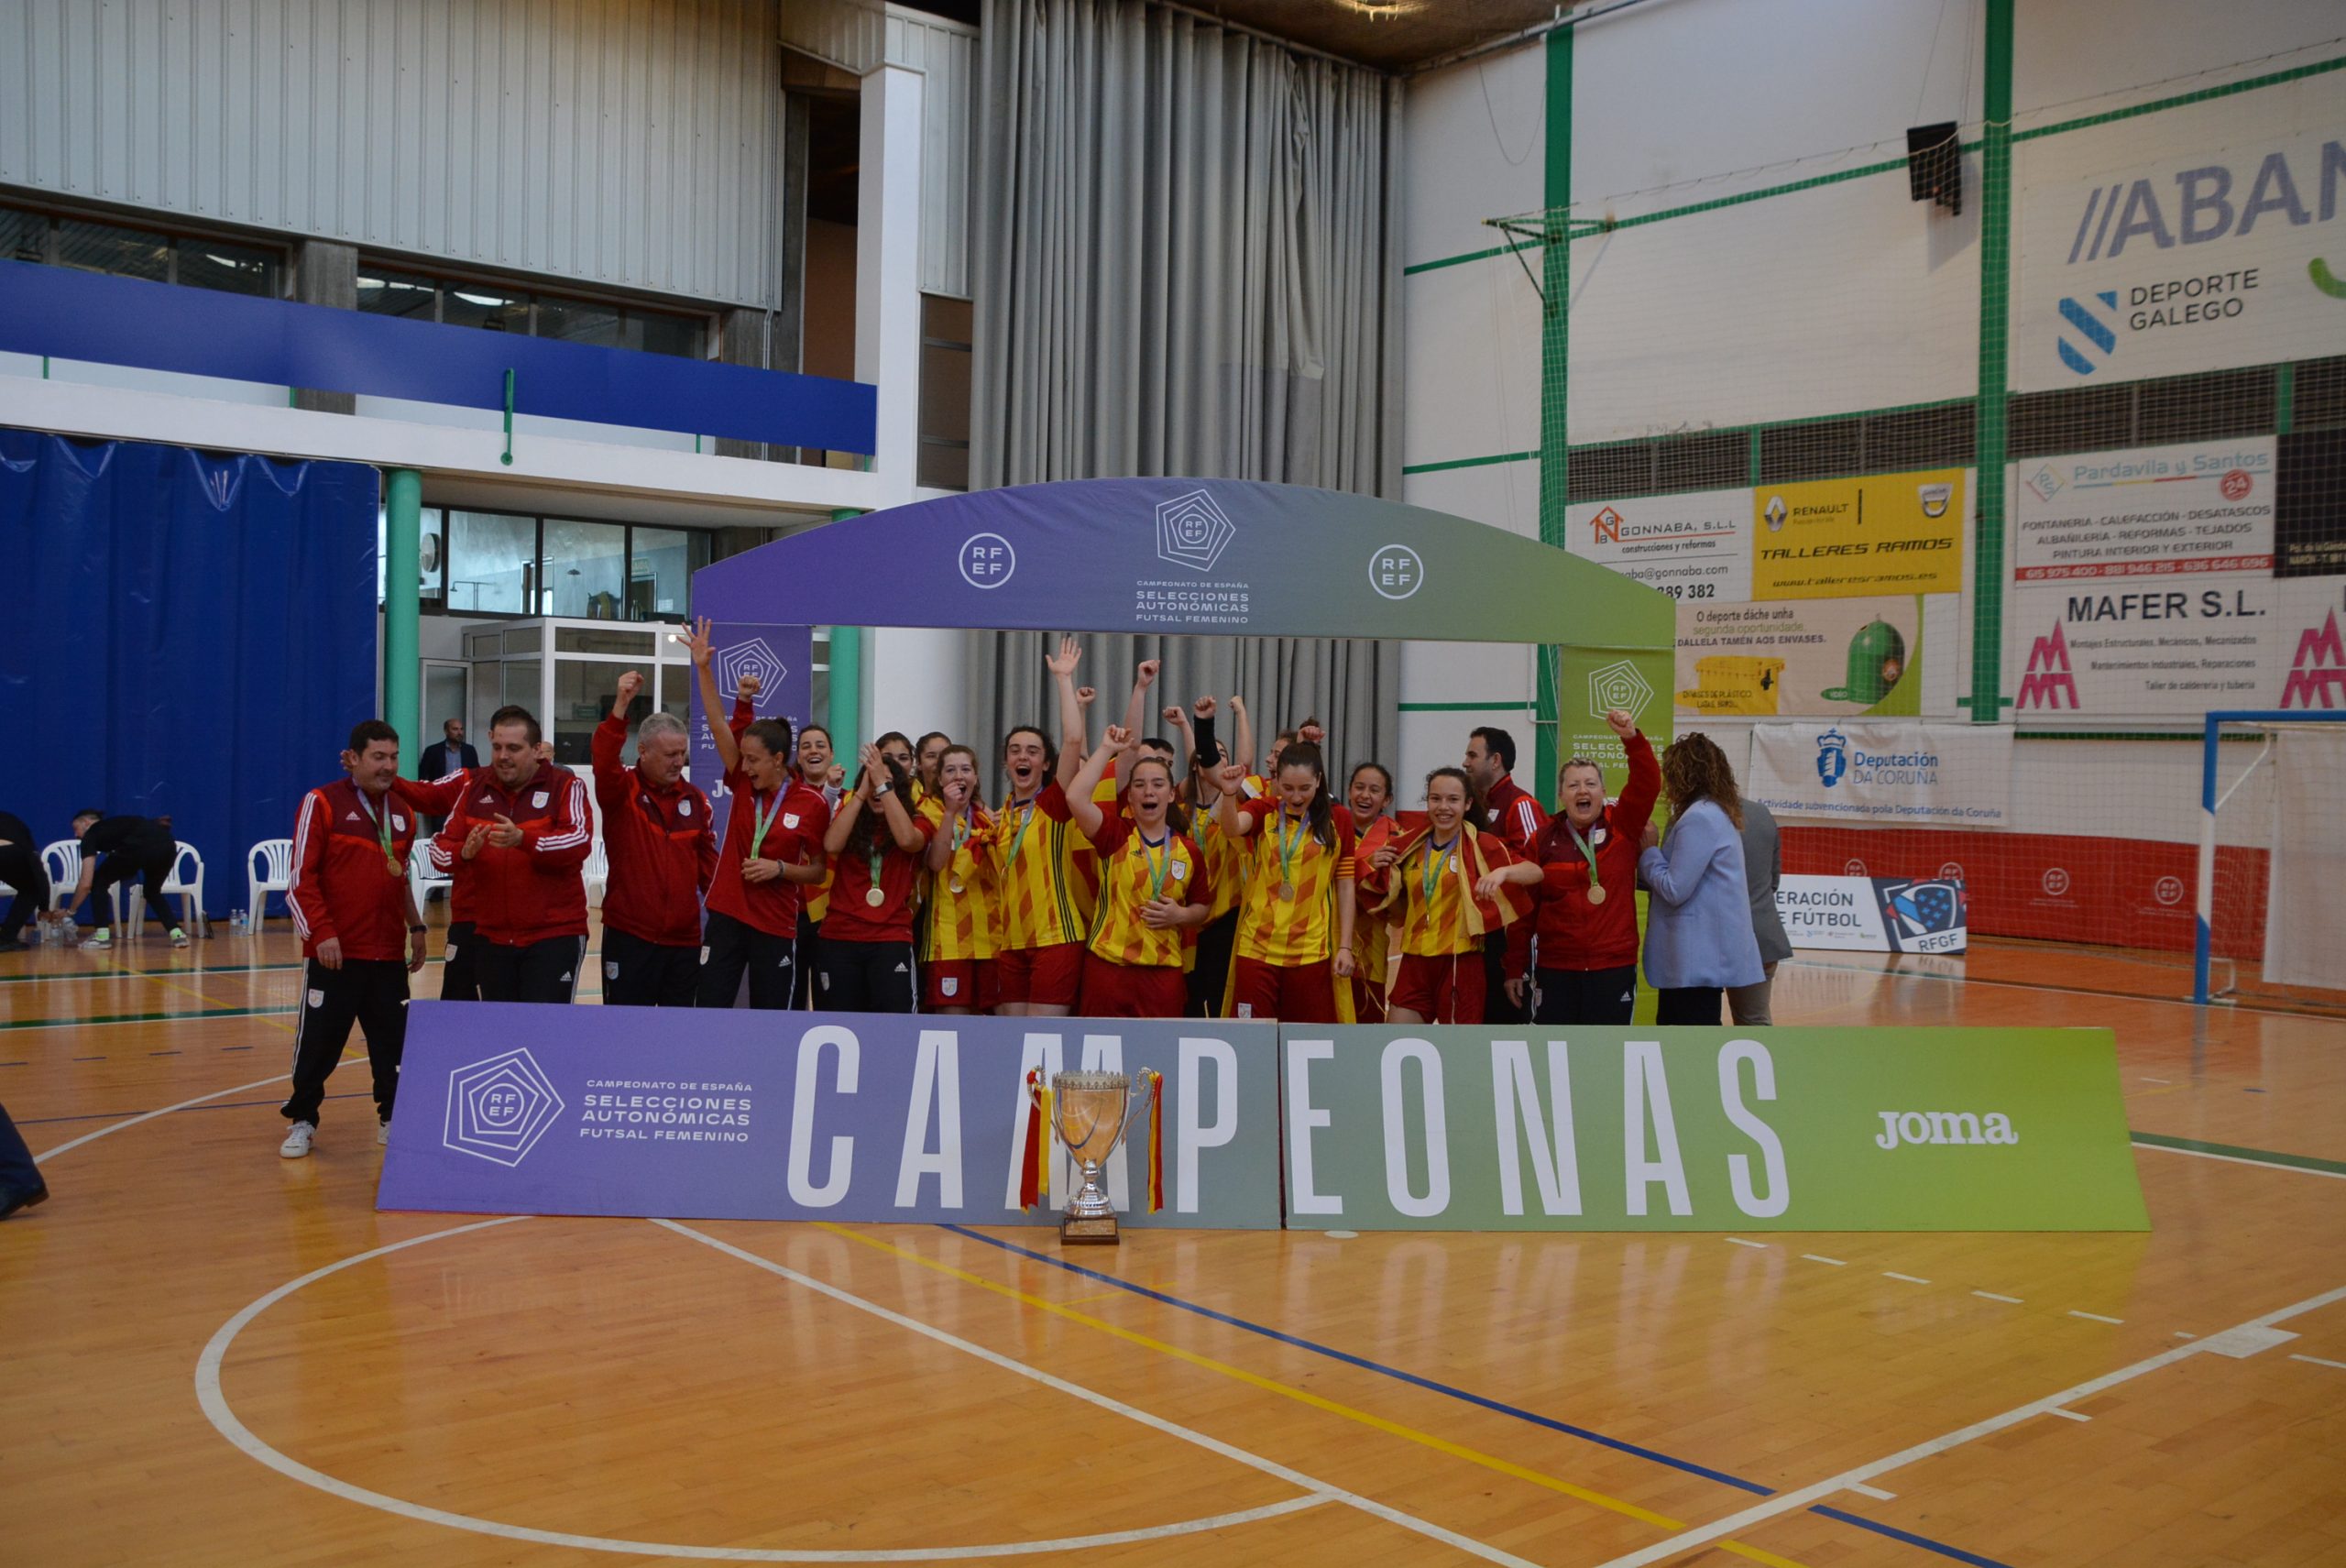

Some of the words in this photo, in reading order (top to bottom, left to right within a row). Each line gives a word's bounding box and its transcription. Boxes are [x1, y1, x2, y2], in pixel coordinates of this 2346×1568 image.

[2130, 269, 2259, 306] DEPORTE
[2130, 298, 2243, 331] GALEGO
[2074, 459, 2169, 482] Pardavila
[2176, 461, 2187, 476] y
[2193, 452, 2268, 471] Santos
[2225, 479, 2247, 495] 24
[1793, 503, 1849, 516] RENAULT
[2100, 510, 2180, 526] CALEFACCIÓN
[2188, 505, 2271, 521] DESATASCOS
[1621, 522, 1697, 537] GONNABA,
[2119, 526, 2186, 541] REFORMAS
[2195, 522, 2253, 535] TEJADOS
[973, 547, 1003, 559] RF
[1622, 542, 1672, 554] construcciones
[1675, 543, 1681, 552] y
[1682, 540, 1716, 550] reformas
[1761, 543, 1869, 560] TALLERES
[1875, 537, 1954, 554] RAMOS
[2053, 547, 2101, 560] PINTURA
[2106, 543, 2159, 556] INTERIOR
[2163, 543, 2169, 554] Y
[2173, 540, 2233, 554] EXTERIOR
[973, 563, 1003, 575] EF
[1382, 558, 1410, 570] RF
[1382, 574, 1410, 586] EF
[1772, 572, 1938, 587] www.talleresramos.es
[1136, 591, 1249, 602] SELECCIONES
[1688, 584, 1715, 598] 382
[1136, 600, 1249, 612] AUTONÓMICAS
[2068, 592, 2188, 622] MAFER
[2200, 590, 2266, 618] S.L.
[1136, 614, 1181, 622] FUTSAL
[1696, 611, 1704, 622] O
[1706, 609, 1741, 625] deporte
[1772, 609, 1793, 620] unha
[1694, 625, 1734, 638] segunda
[1757, 636, 1775, 644] AOS
[1854, 751, 1939, 770] Deputación
[1853, 770, 1872, 784] DA
[1879, 767, 1938, 785] CORUÑA
[1758, 798, 1803, 810] Actividade
[1805, 800, 1870, 814] subvencionada
[1872, 803, 1893, 815] pola
[1896, 804, 1950, 816] Deputación
[1951, 806, 1964, 817] da
[1966, 806, 2001, 818] Coruña
[1776, 889, 1853, 906] ERACIÓN
[1792, 908, 1861, 927] FÚTBOL
[1918, 933, 1957, 953] RFGF
[586, 1080, 676, 1090] CAMPEONATO
[702, 1082, 752, 1091] ESPAÑA
[491, 1093, 516, 1103] RF
[584, 1094, 752, 1111] SELECCIONES
[489, 1106, 514, 1116] EF
[582, 1108, 751, 1125] AUTONÓMICAS
[787, 1025, 1791, 1219] CAMPEONAS
[580, 1128, 648, 1139] FUTSAL
[654, 1131, 749, 1142] FEMENINO
